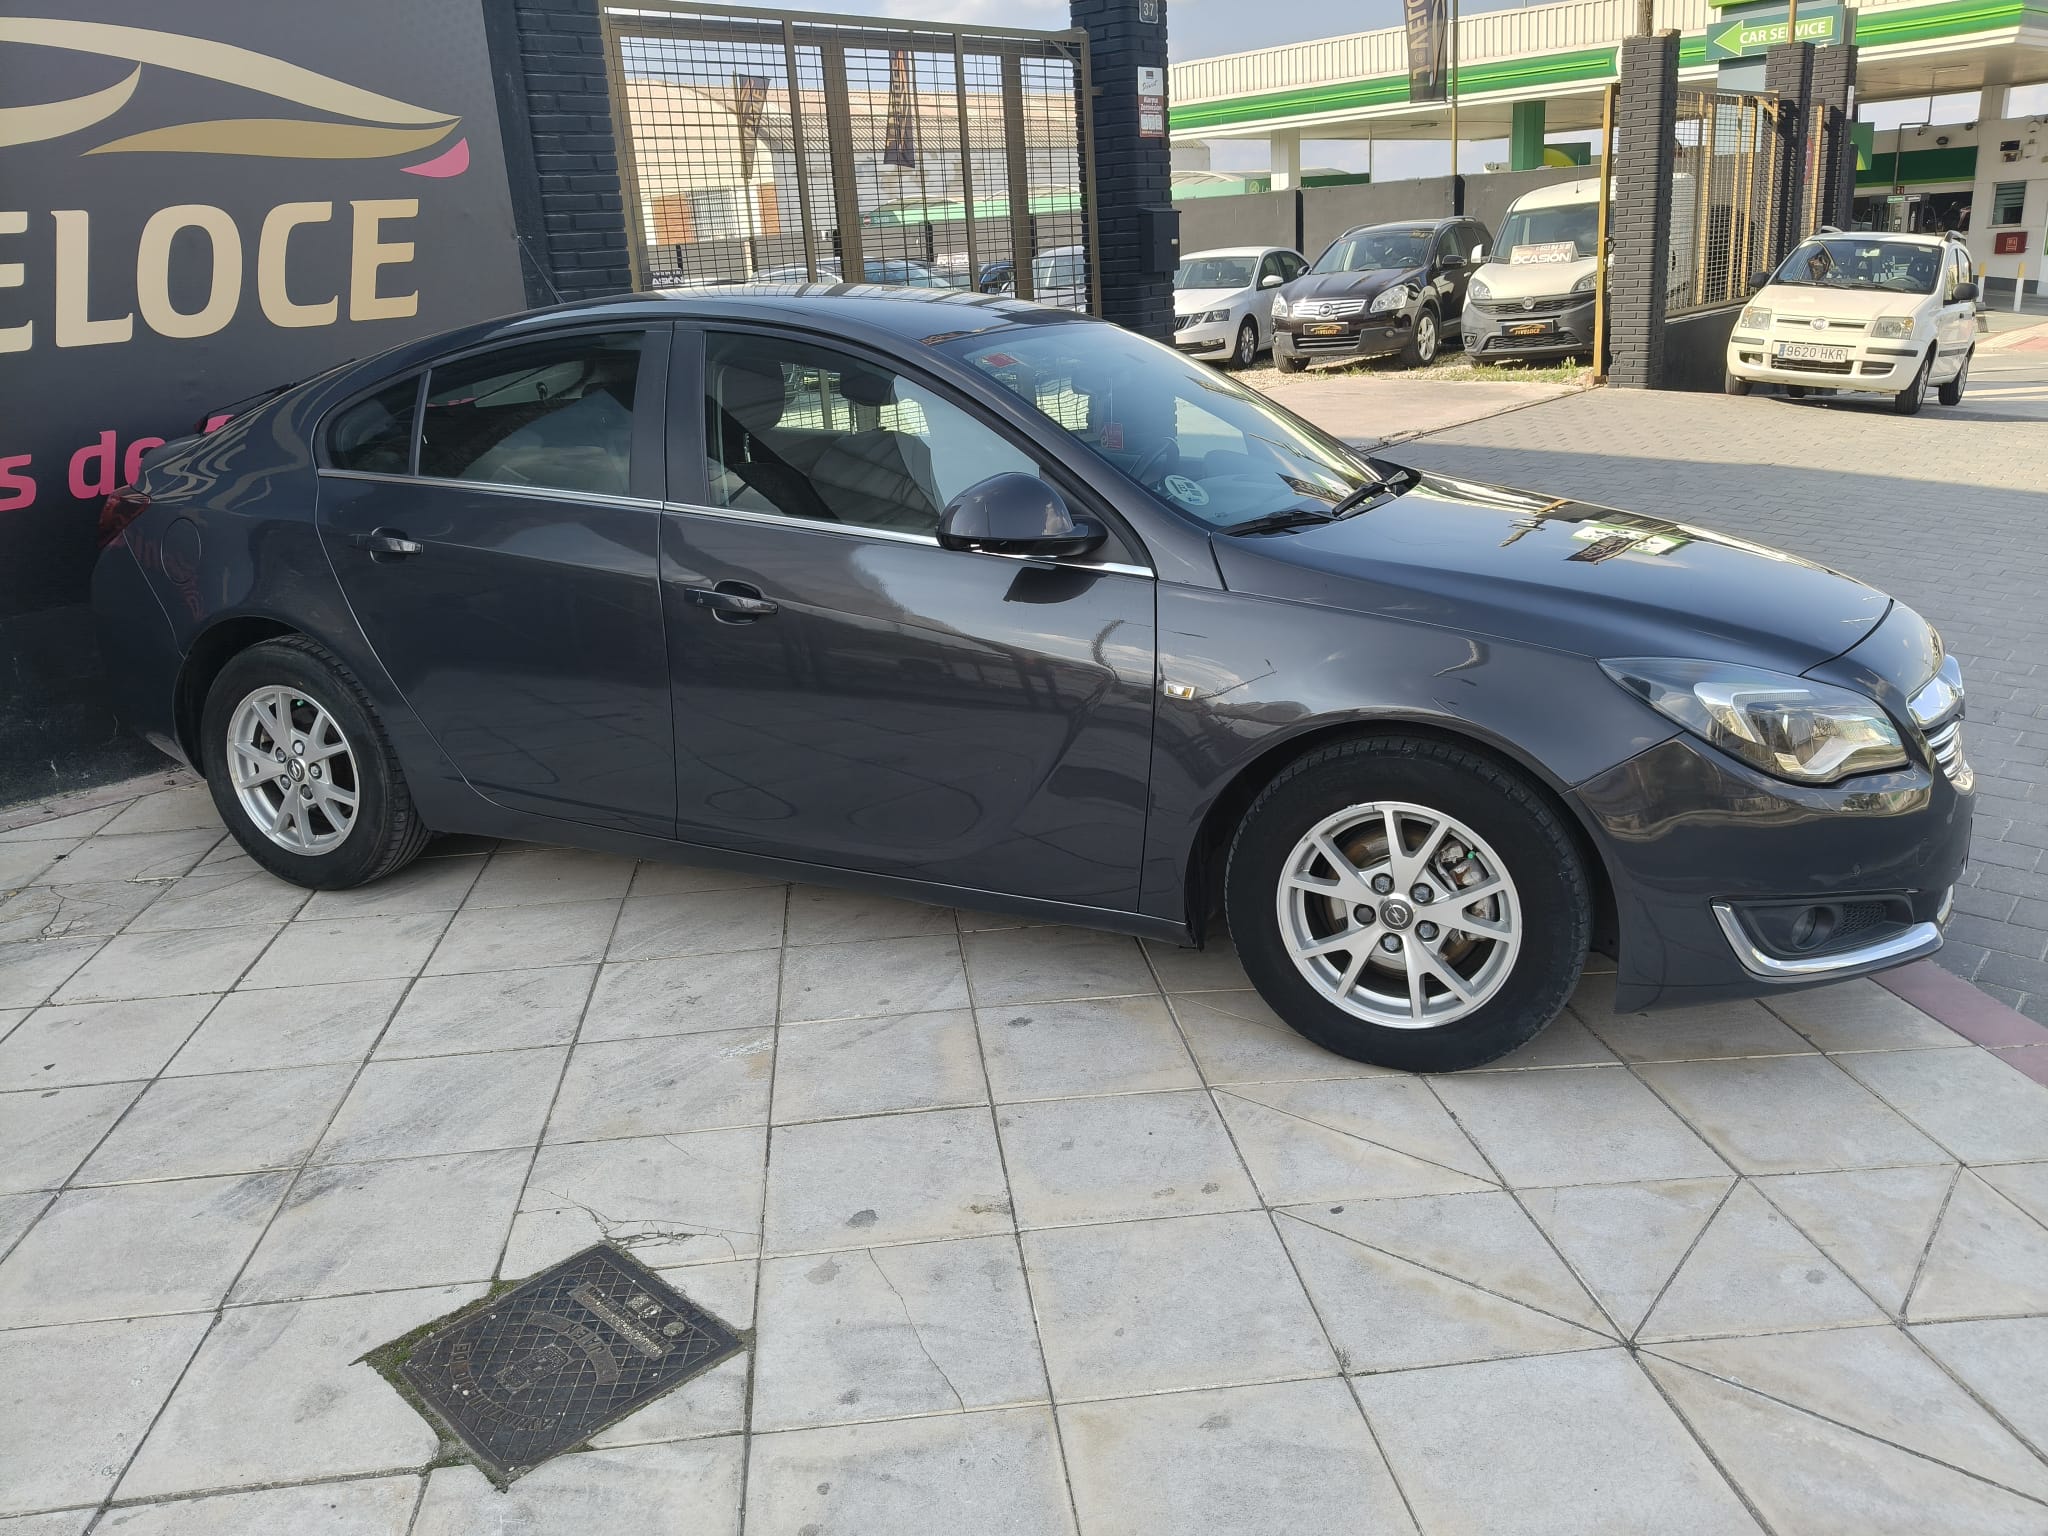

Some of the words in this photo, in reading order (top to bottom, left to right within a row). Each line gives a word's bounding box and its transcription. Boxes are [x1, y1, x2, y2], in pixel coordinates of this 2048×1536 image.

[1740, 30, 1767, 44] CAR
[1786, 345, 1817, 358] 9620
[1820, 347, 1844, 361] HKR
